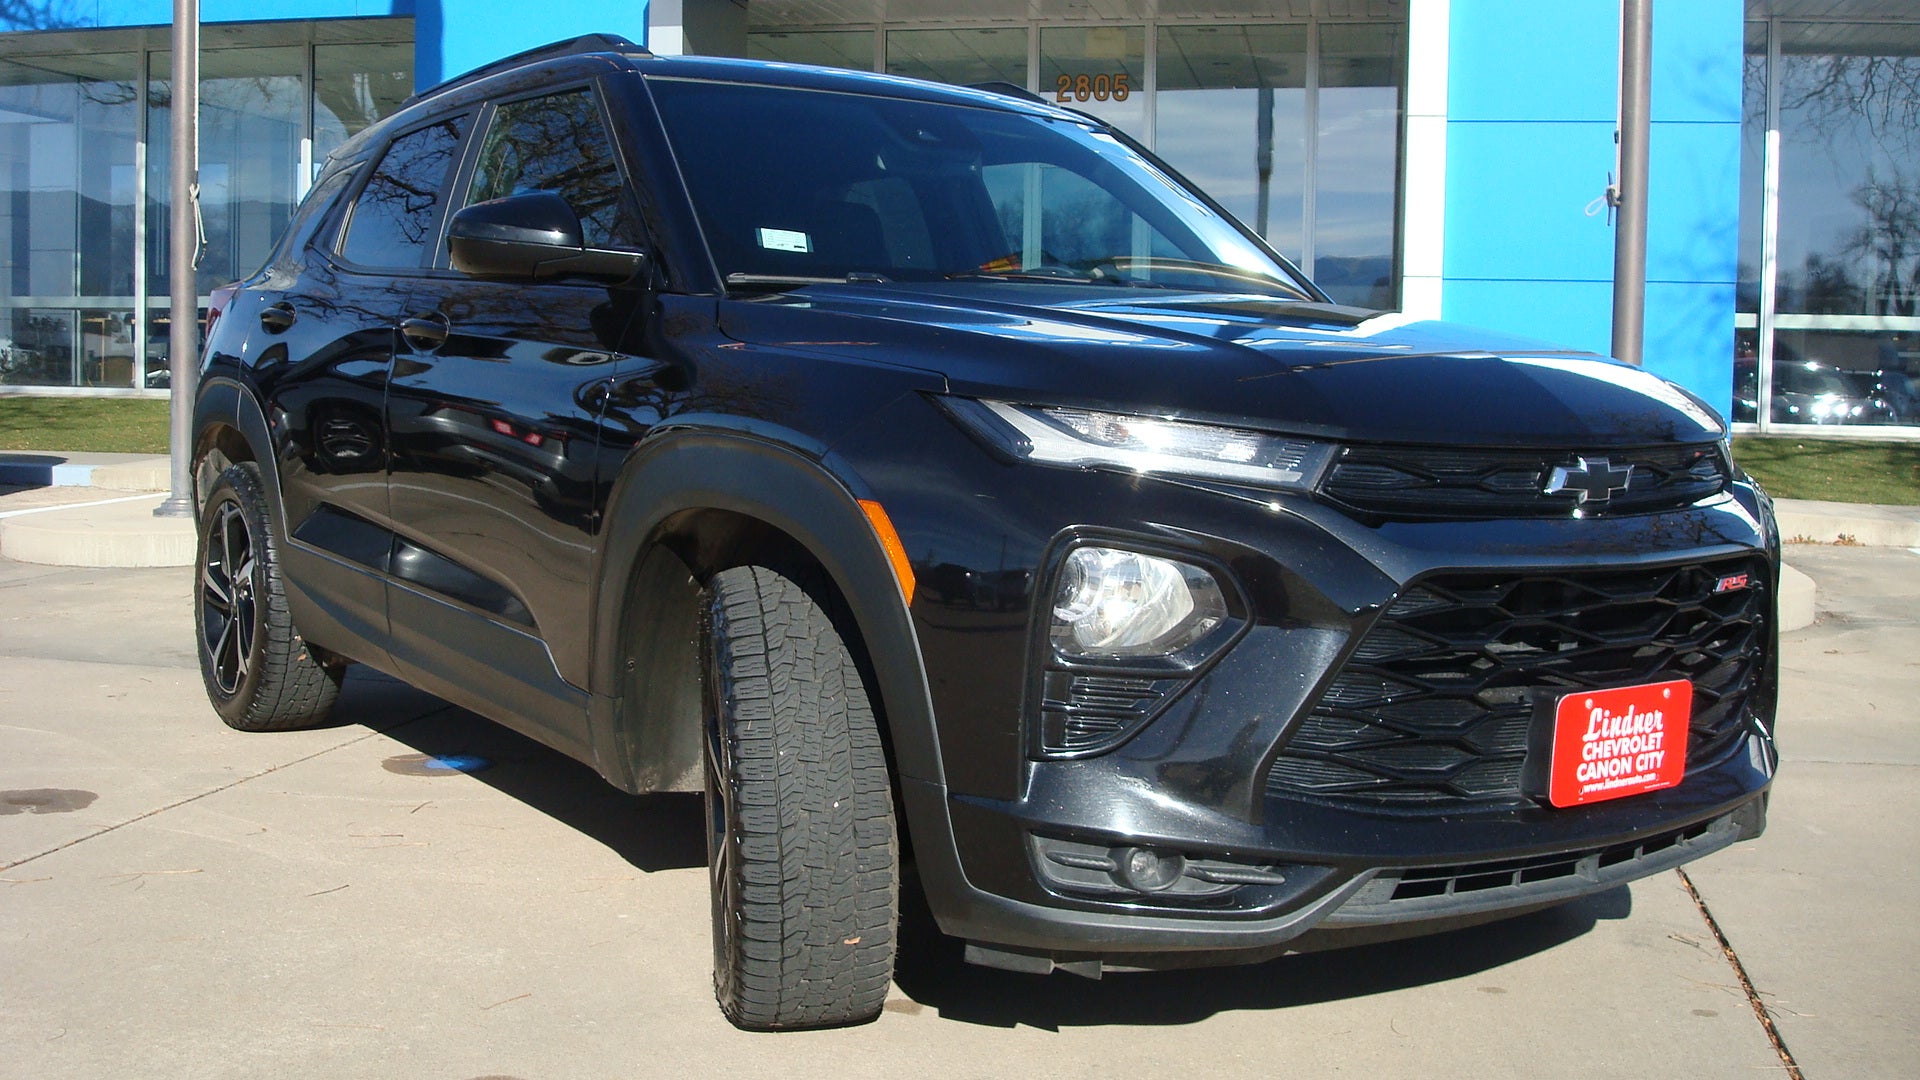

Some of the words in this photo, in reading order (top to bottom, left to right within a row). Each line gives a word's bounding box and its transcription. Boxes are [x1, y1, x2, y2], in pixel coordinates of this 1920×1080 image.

[1056, 73, 1130, 103] 2805
[1715, 573, 1749, 592] RS
[1582, 704, 1664, 742] Lindner
[1582, 731, 1664, 761] CHEVROLET
[1576, 755, 1633, 782] CANON
[1635, 750, 1665, 773] CITY
